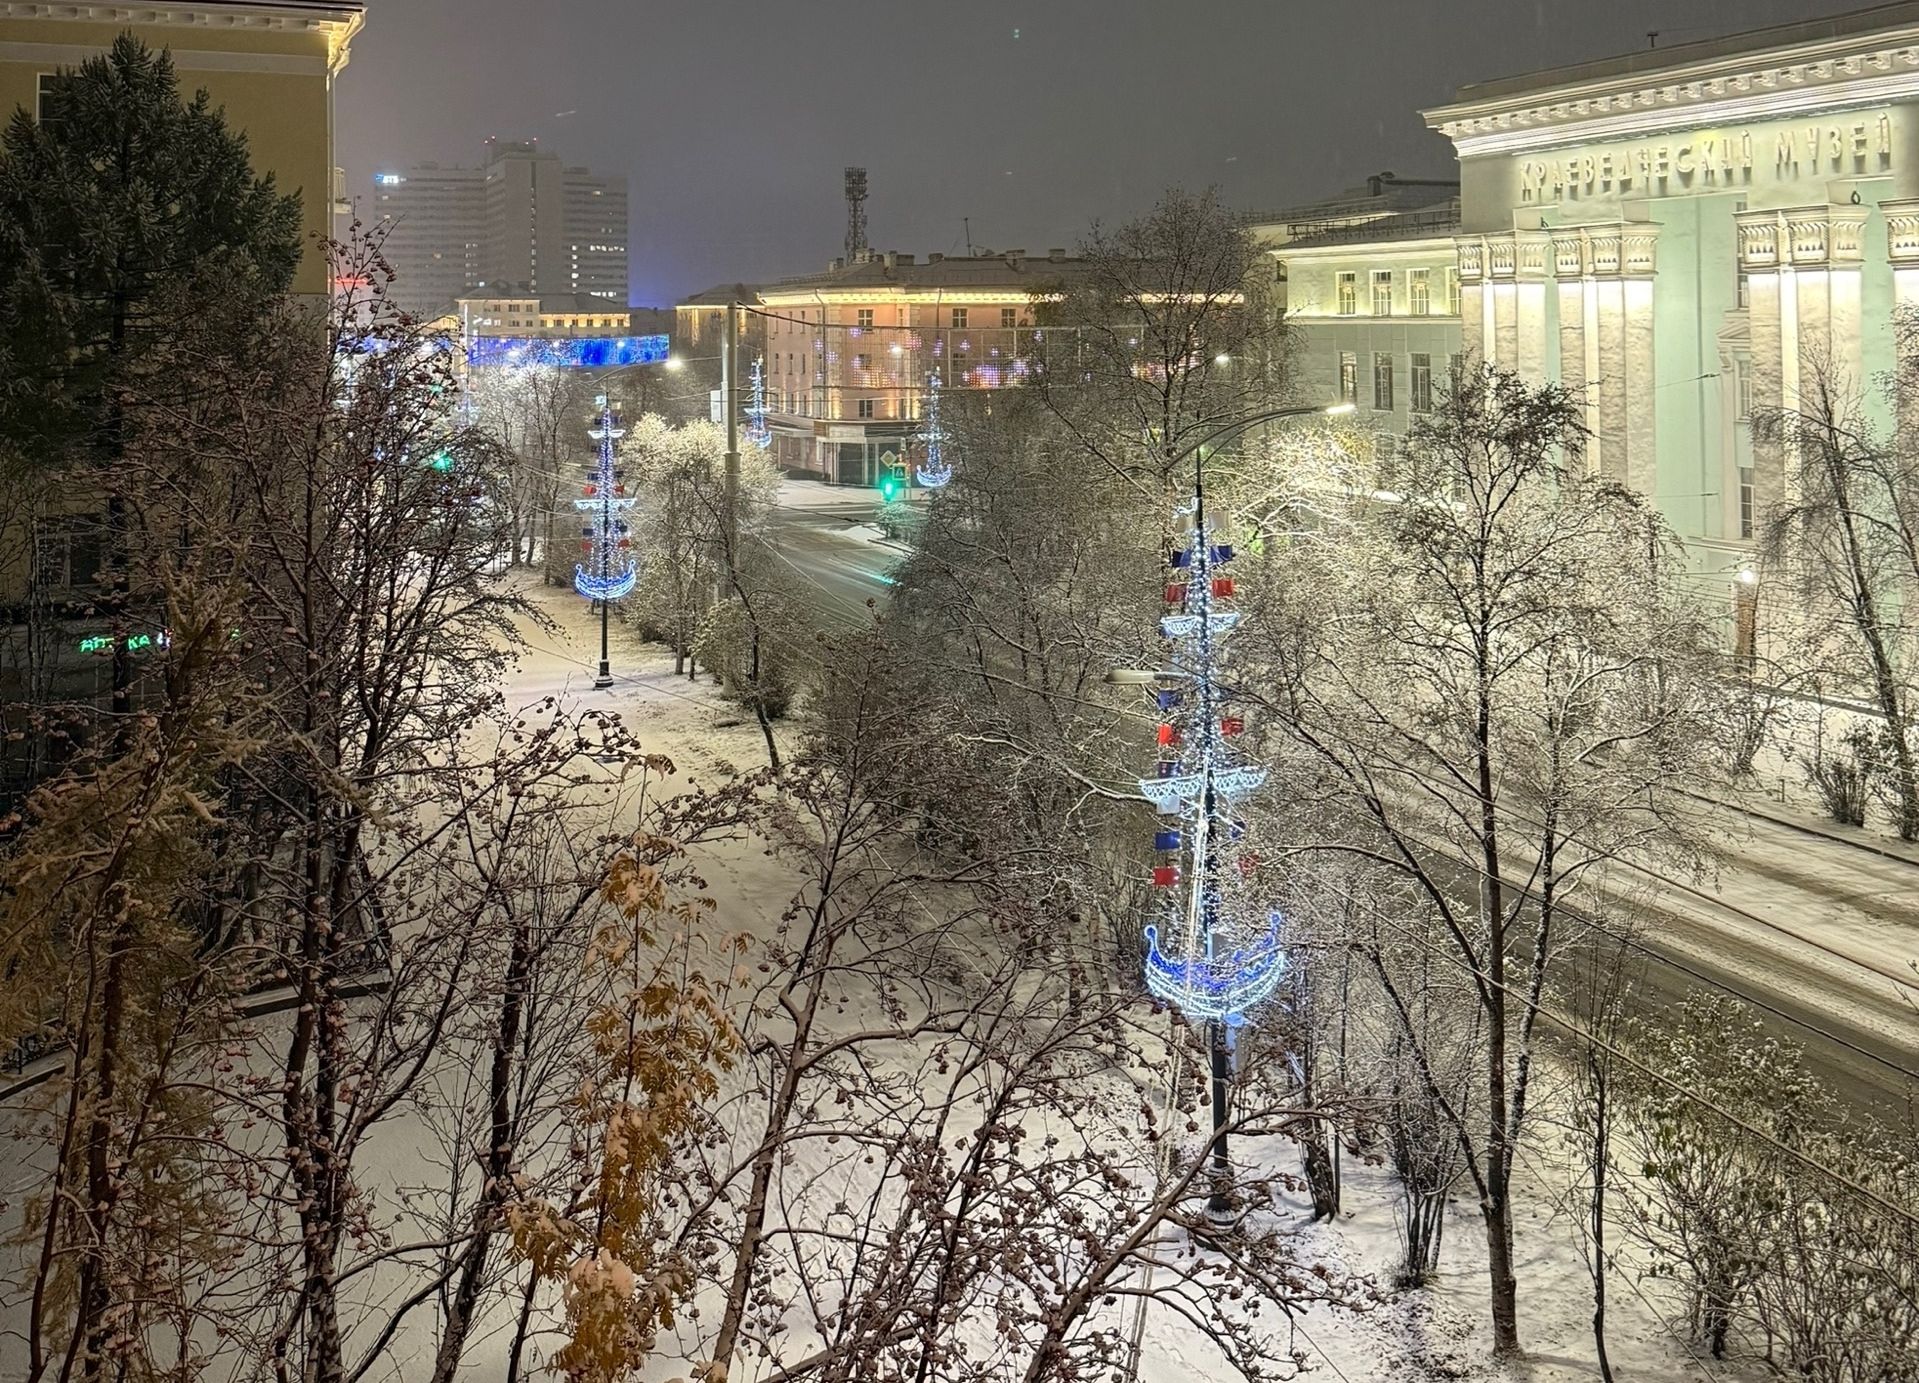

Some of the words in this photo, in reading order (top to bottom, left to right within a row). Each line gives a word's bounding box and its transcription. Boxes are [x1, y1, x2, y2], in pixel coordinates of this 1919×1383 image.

[1519, 130, 1752, 192] КРАЕВЕДЧЕСКИЙ
[1776, 113, 1890, 166] МУЗЕЙ
[80, 635, 150, 652] АПТКА
